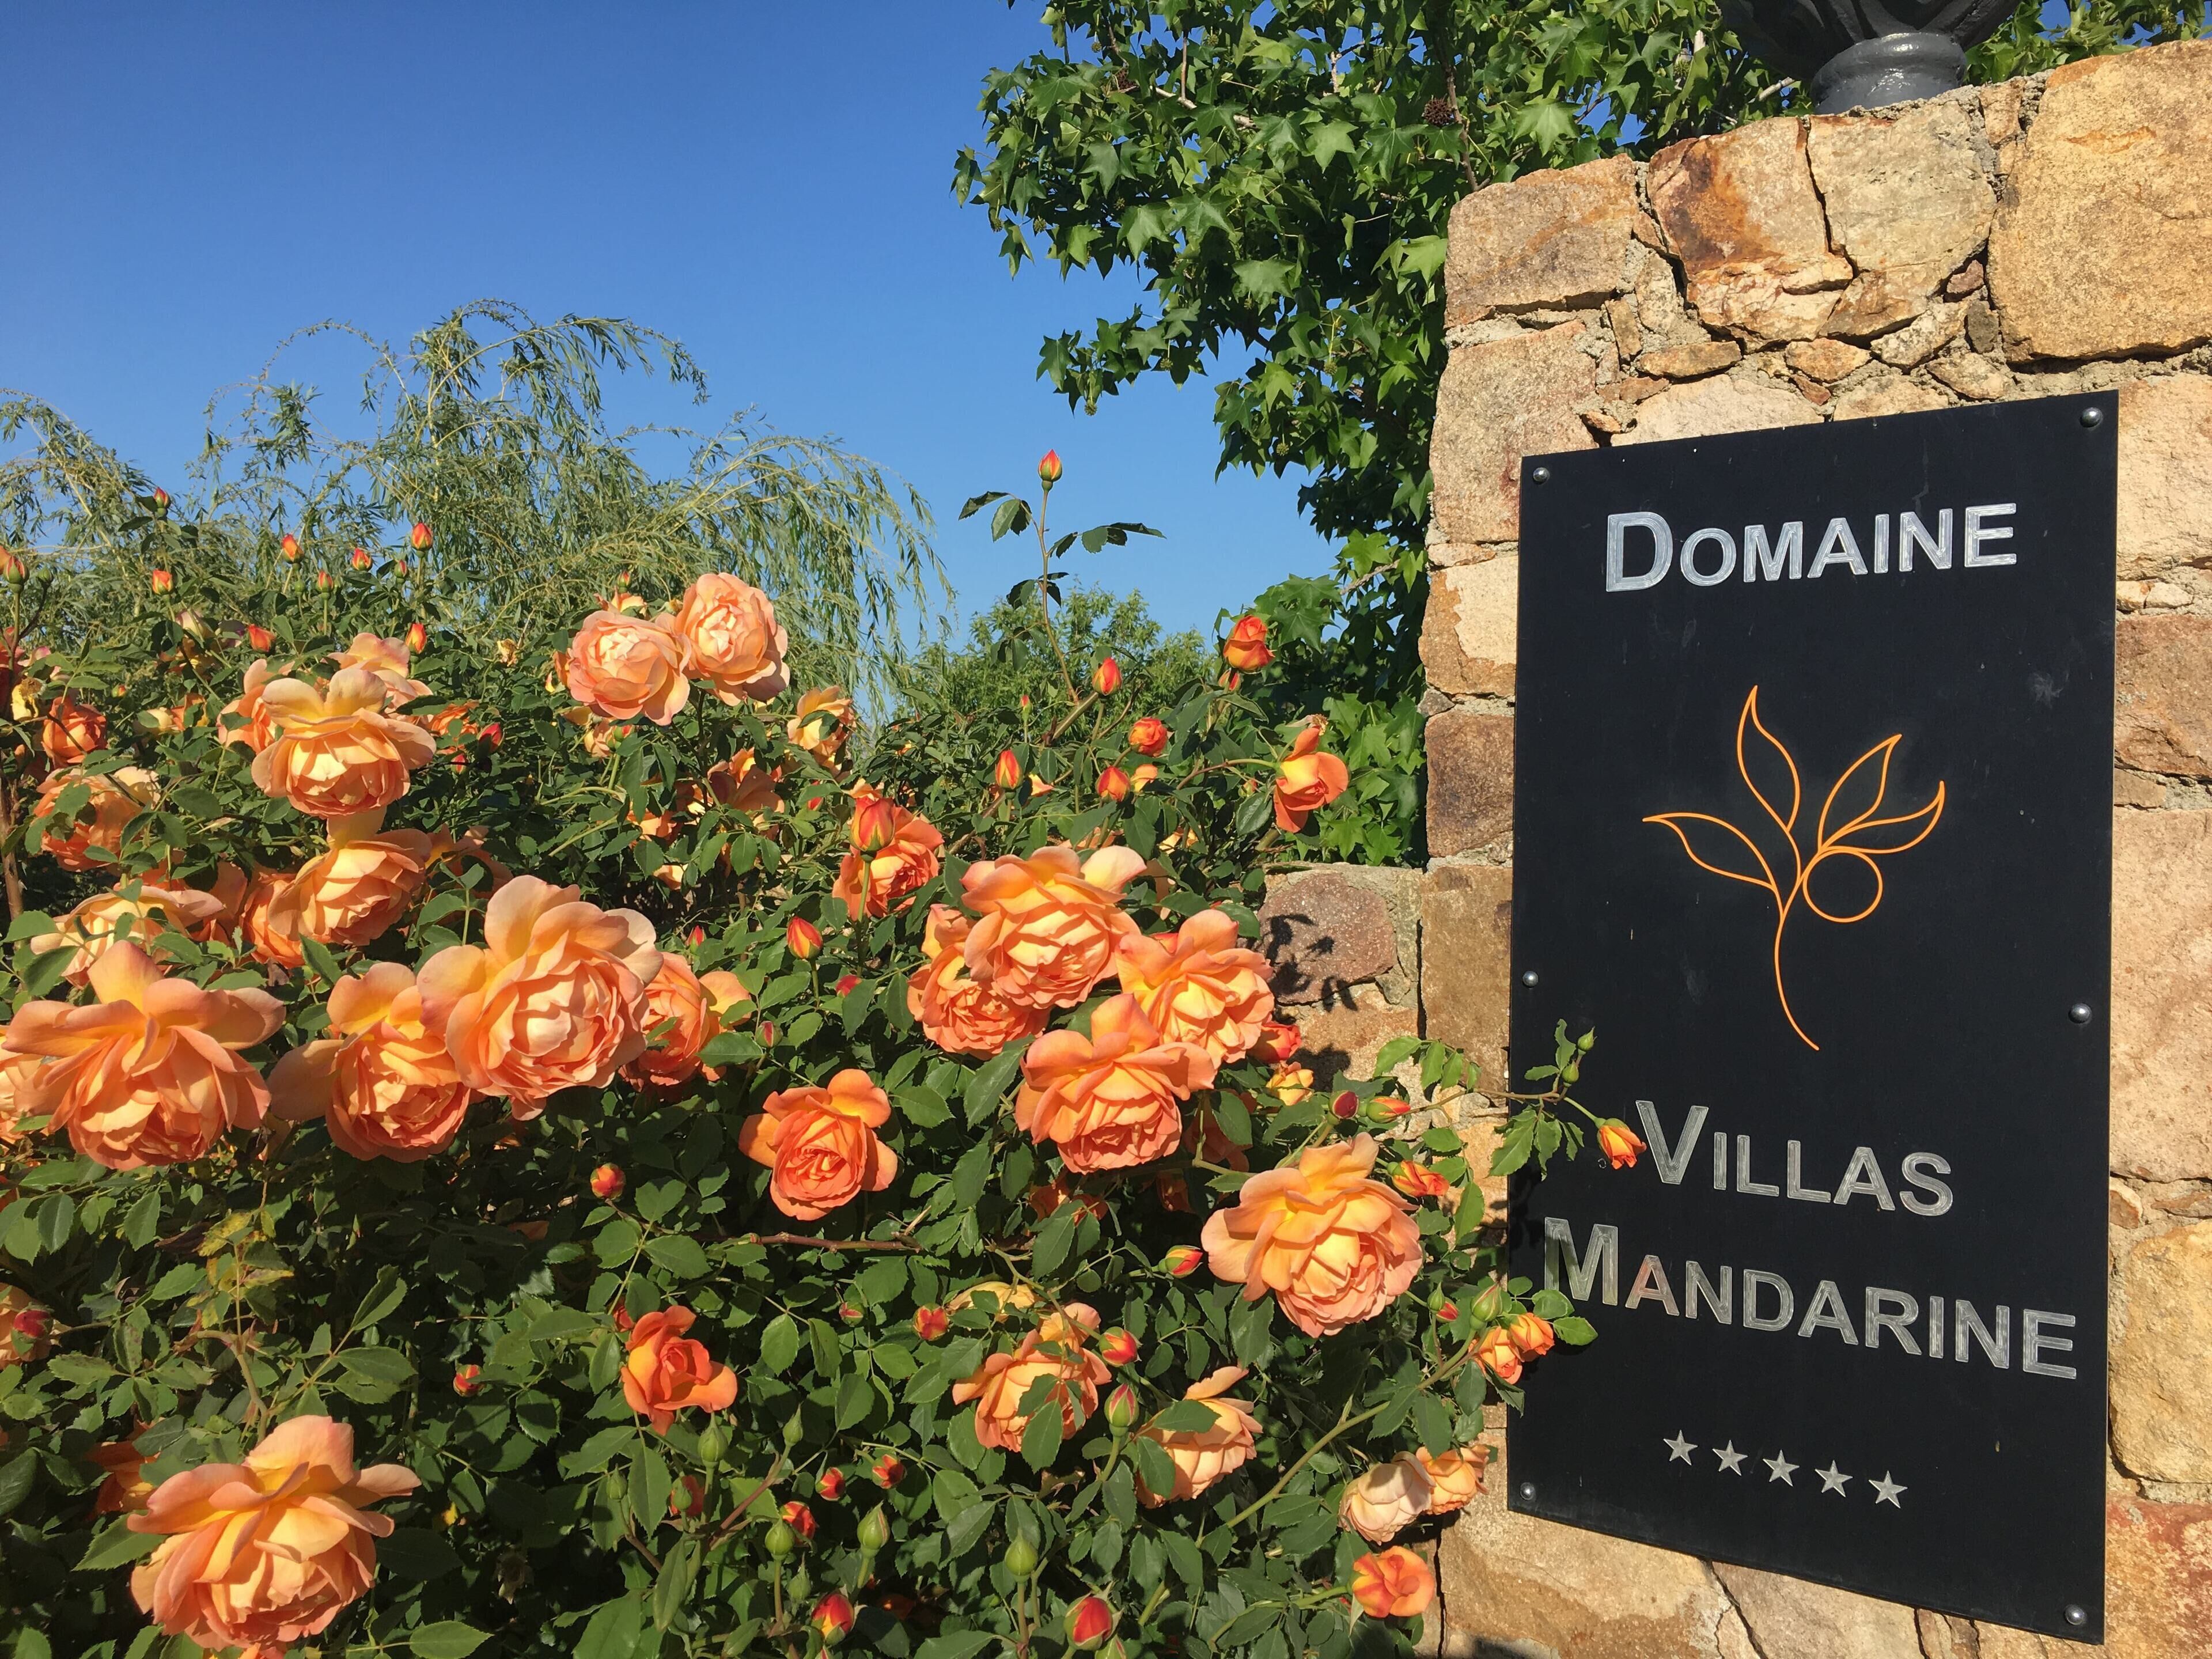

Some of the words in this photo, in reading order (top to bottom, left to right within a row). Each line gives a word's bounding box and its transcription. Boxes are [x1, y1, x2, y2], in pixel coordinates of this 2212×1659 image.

[1606, 503, 2016, 592] DOMAINE
[1635, 1100, 1953, 1217] VILLAS
[1544, 1217, 2077, 1379] MANDARINE
